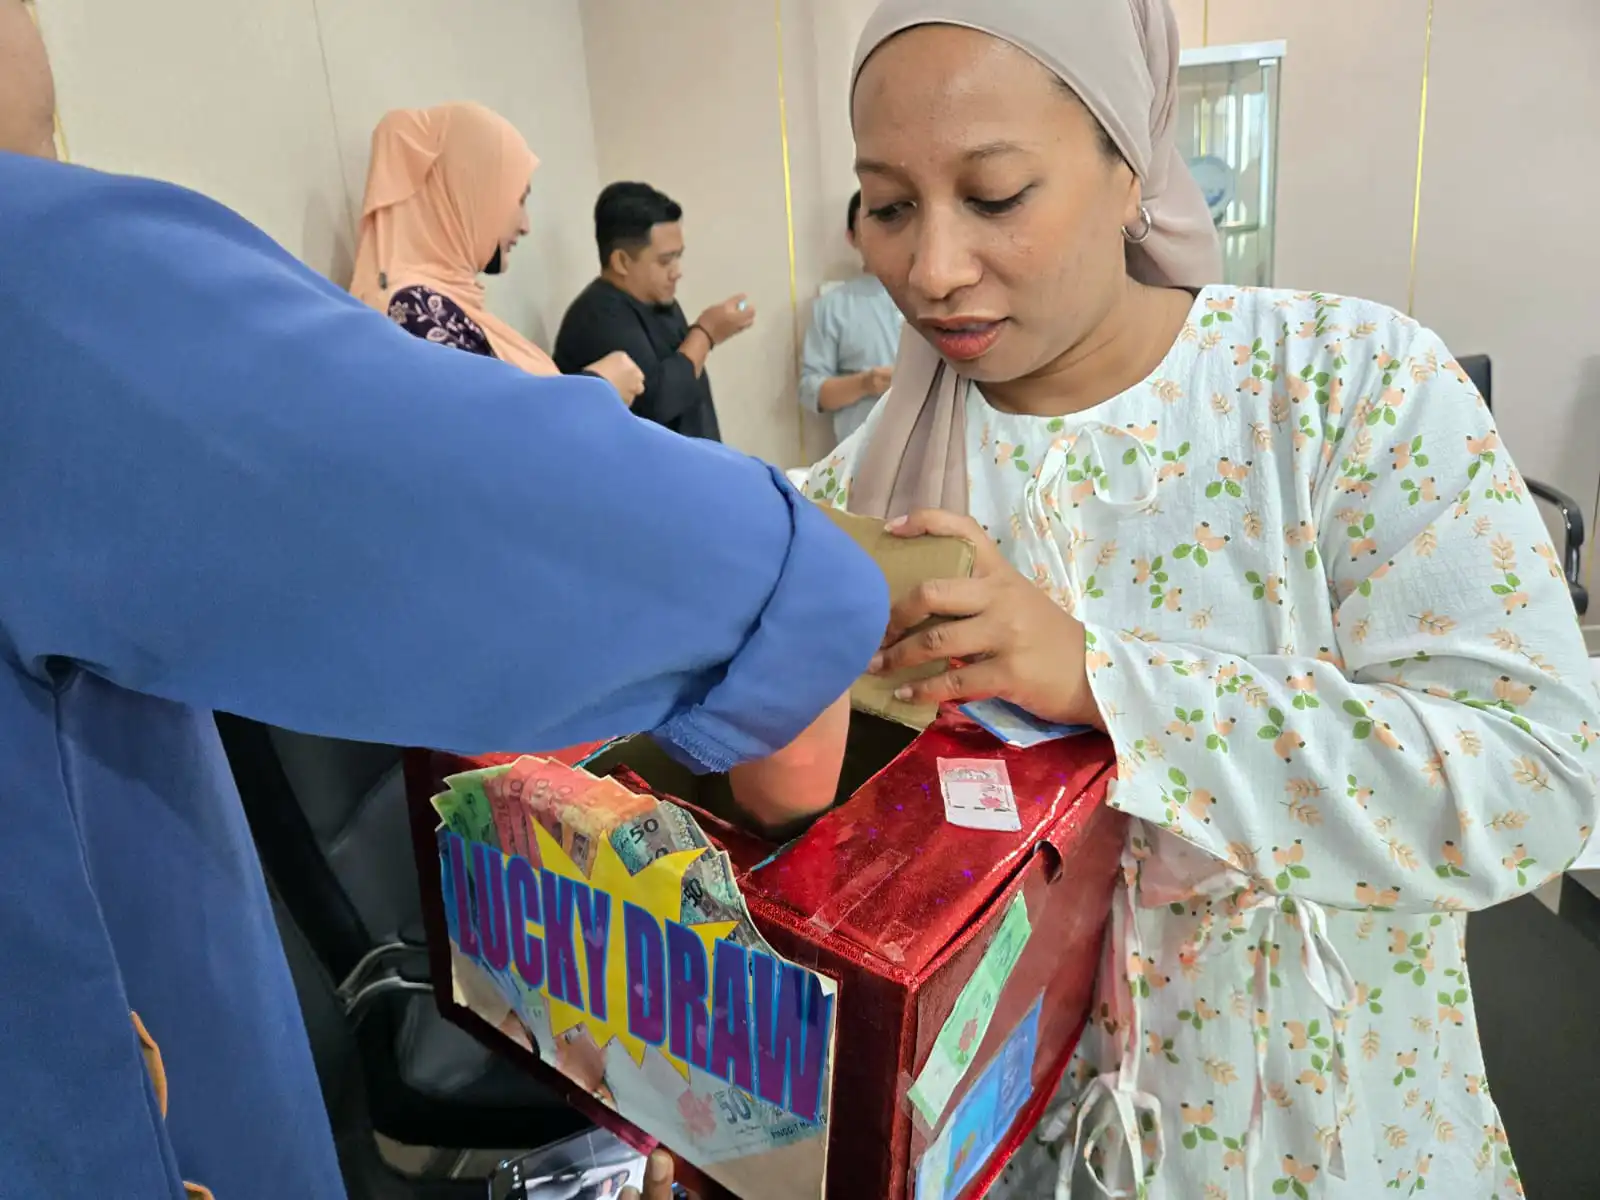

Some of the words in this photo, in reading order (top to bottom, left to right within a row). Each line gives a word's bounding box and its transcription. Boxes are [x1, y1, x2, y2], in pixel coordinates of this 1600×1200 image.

[629, 818, 659, 845] 50
[448, 831, 611, 1022] LUCKY
[622, 900, 834, 1124] DRAW
[720, 1085, 752, 1125] 50
